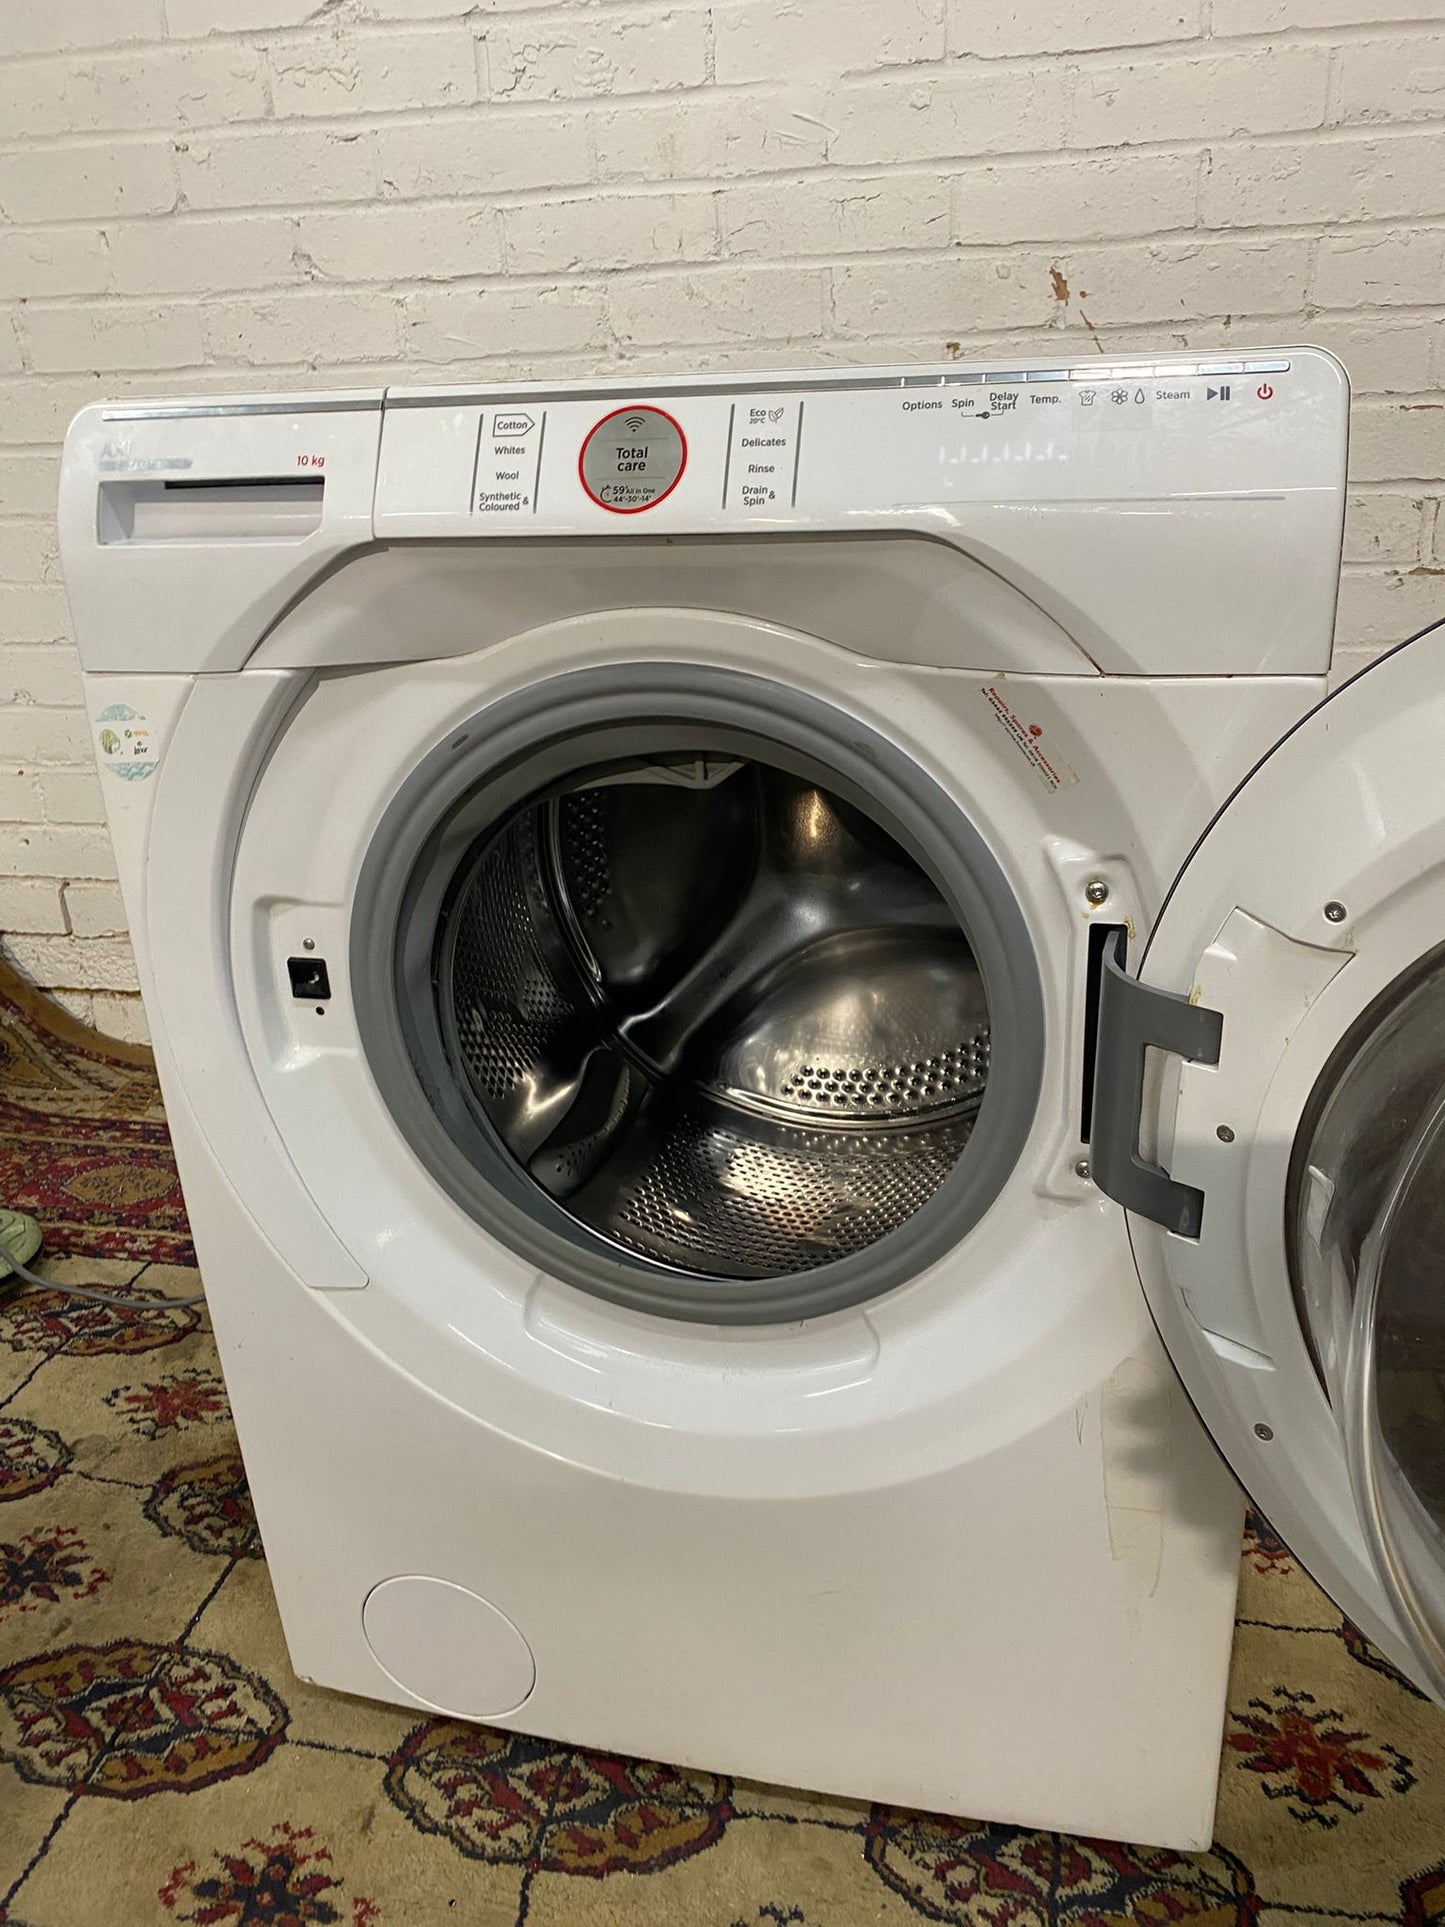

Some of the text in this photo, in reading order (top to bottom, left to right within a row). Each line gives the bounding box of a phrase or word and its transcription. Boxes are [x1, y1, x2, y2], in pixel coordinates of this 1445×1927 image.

[989, 391, 1019, 402] Delay
[1030, 394, 1062, 404] Temp.
[1155, 390, 1190, 400] Steam
[902, 400, 943, 412] Options
[951, 397, 975, 409] Spin
[990, 400, 1017, 411] Start
[749, 408, 767, 417] Eco
[497, 421, 528, 430] Cotton
[741, 437, 787, 448] Delicates
[494, 445, 526, 455] Whites
[616, 446, 649, 460] Total
[296, 454, 325, 468] 10 kg
[617, 461, 647, 472] care
[748, 463, 776, 474] Rinse
[495, 470, 520, 480] Wool
[741, 485, 776, 500] Drain &
[479, 491, 529, 506] Synthetic &
[743, 495, 766, 507] Spin
[478, 502, 520, 511] Coloured
[989, 687, 1010, 715] Repairs,
[1010, 714, 1029, 738] Spares
[1032, 745, 1061, 783] Accessories
